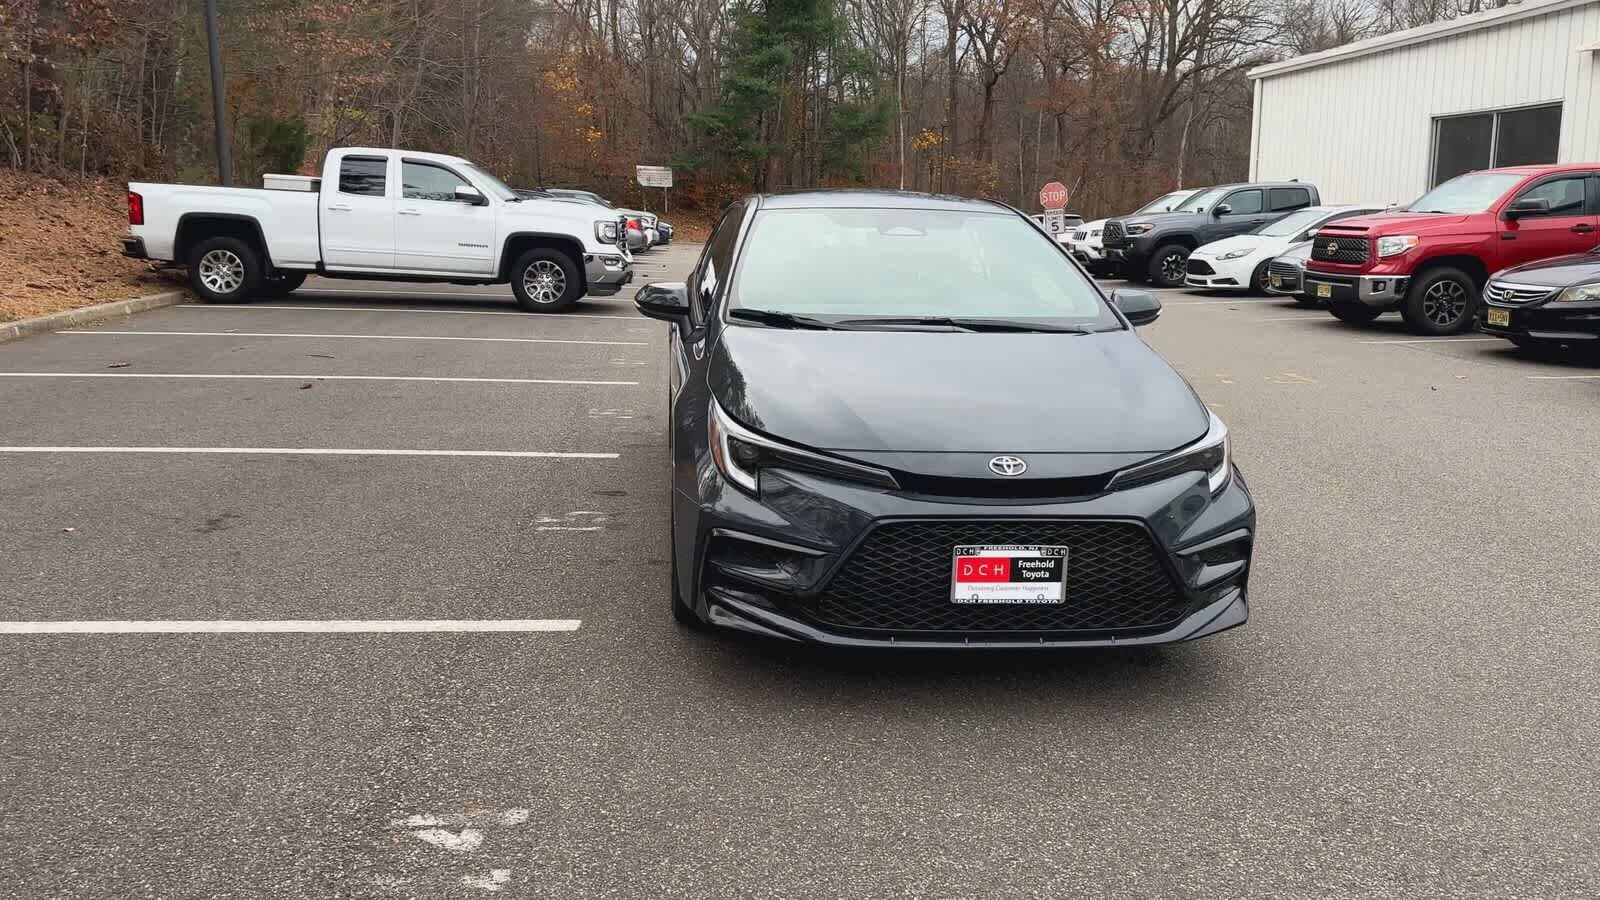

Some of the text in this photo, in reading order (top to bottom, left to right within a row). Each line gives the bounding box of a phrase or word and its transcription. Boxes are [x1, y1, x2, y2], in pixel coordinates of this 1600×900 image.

[1042, 190, 1065, 202] STOP
[1051, 221, 1059, 232] 5
[1018, 560, 1055, 568] Freehold
[1022, 570, 1050, 580] Toyota
